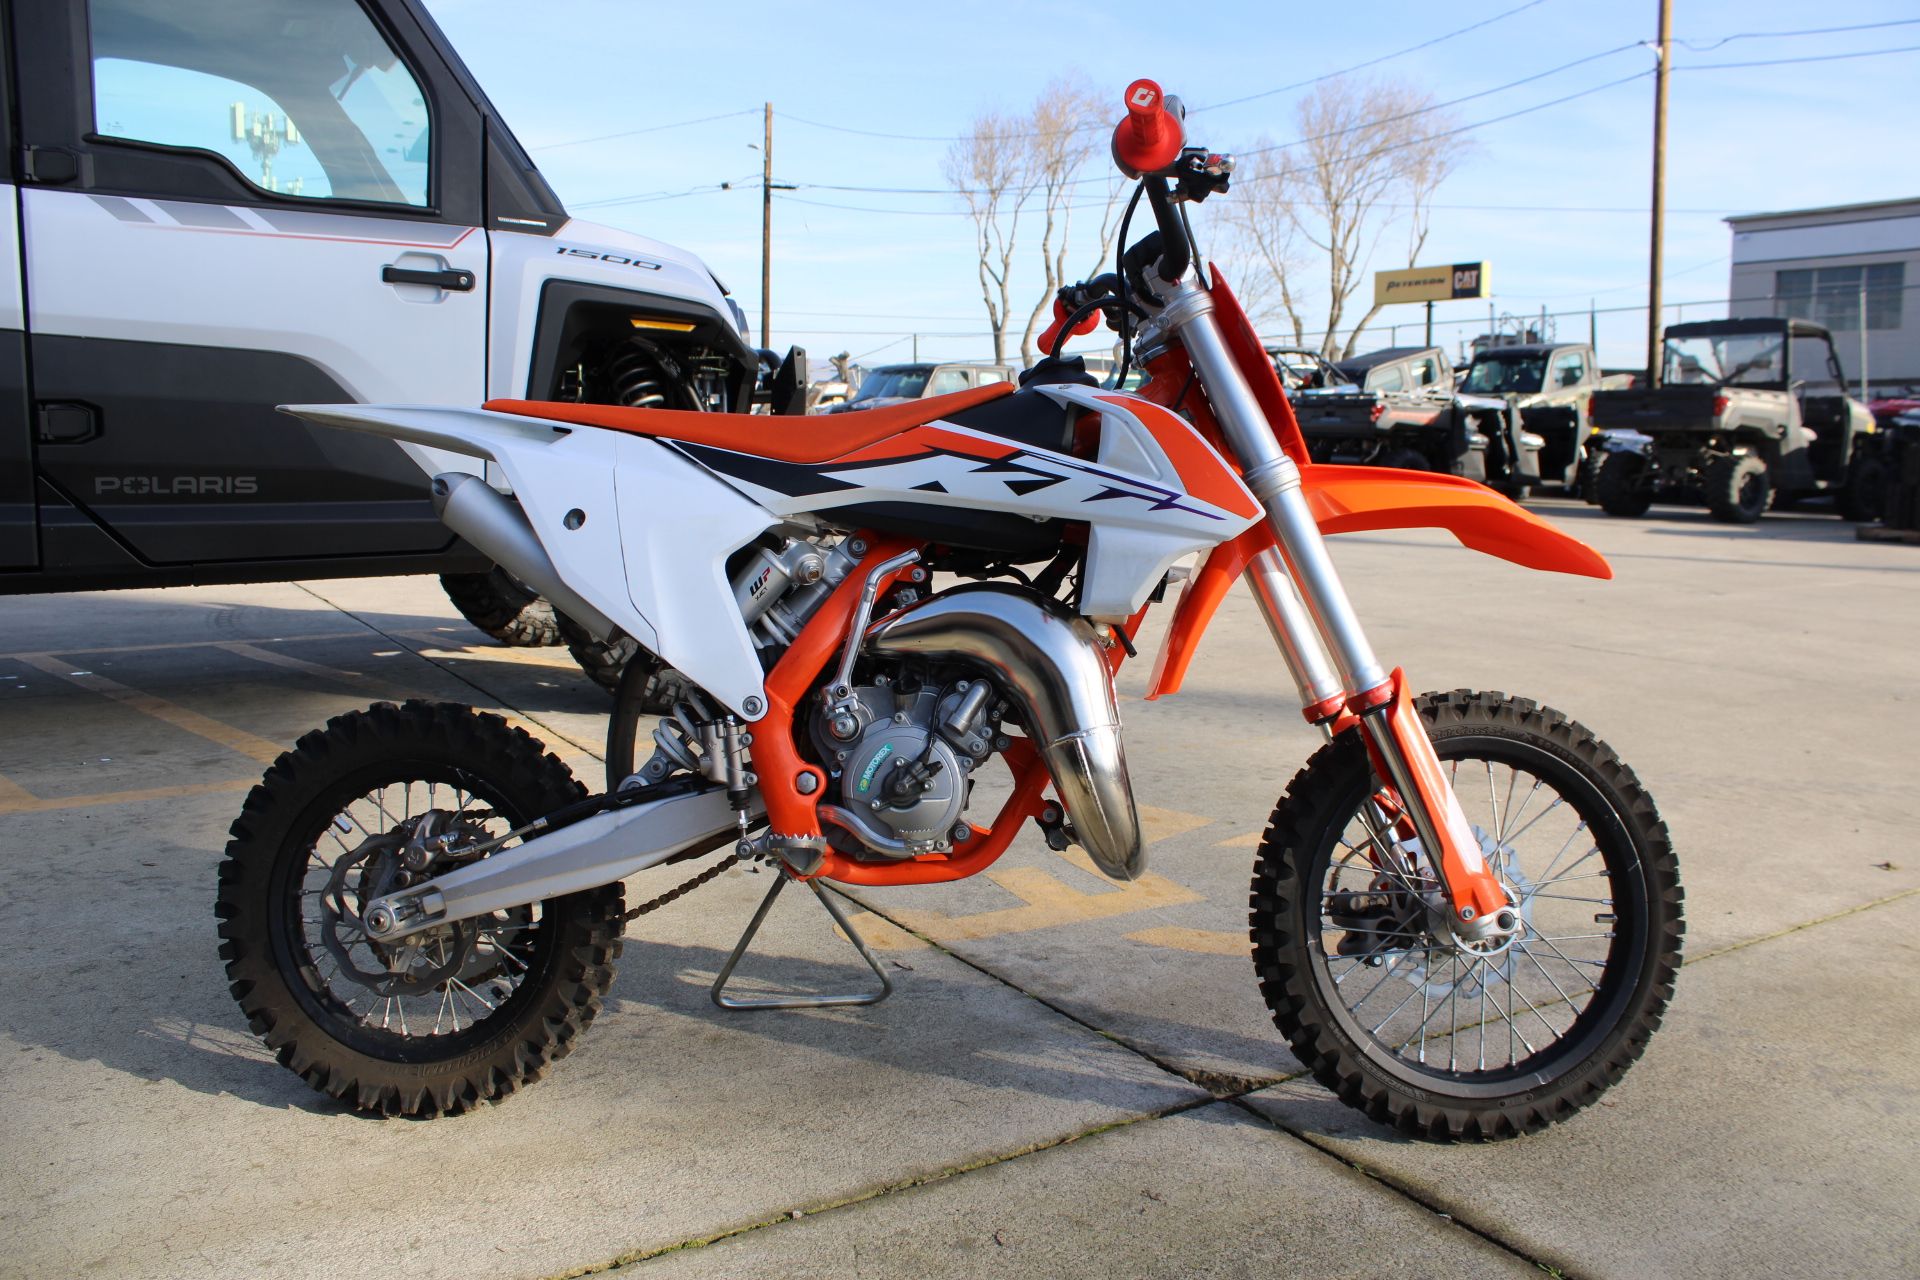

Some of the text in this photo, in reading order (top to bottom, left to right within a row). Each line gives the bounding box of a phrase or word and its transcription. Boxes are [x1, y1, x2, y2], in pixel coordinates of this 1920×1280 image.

[556, 246, 663, 271] 1500
[1454, 270, 1479, 290] CAT
[94, 476, 259, 495] POLARIS
[749, 566, 771, 596] WP
[863, 745, 891, 780] MOTOREX
